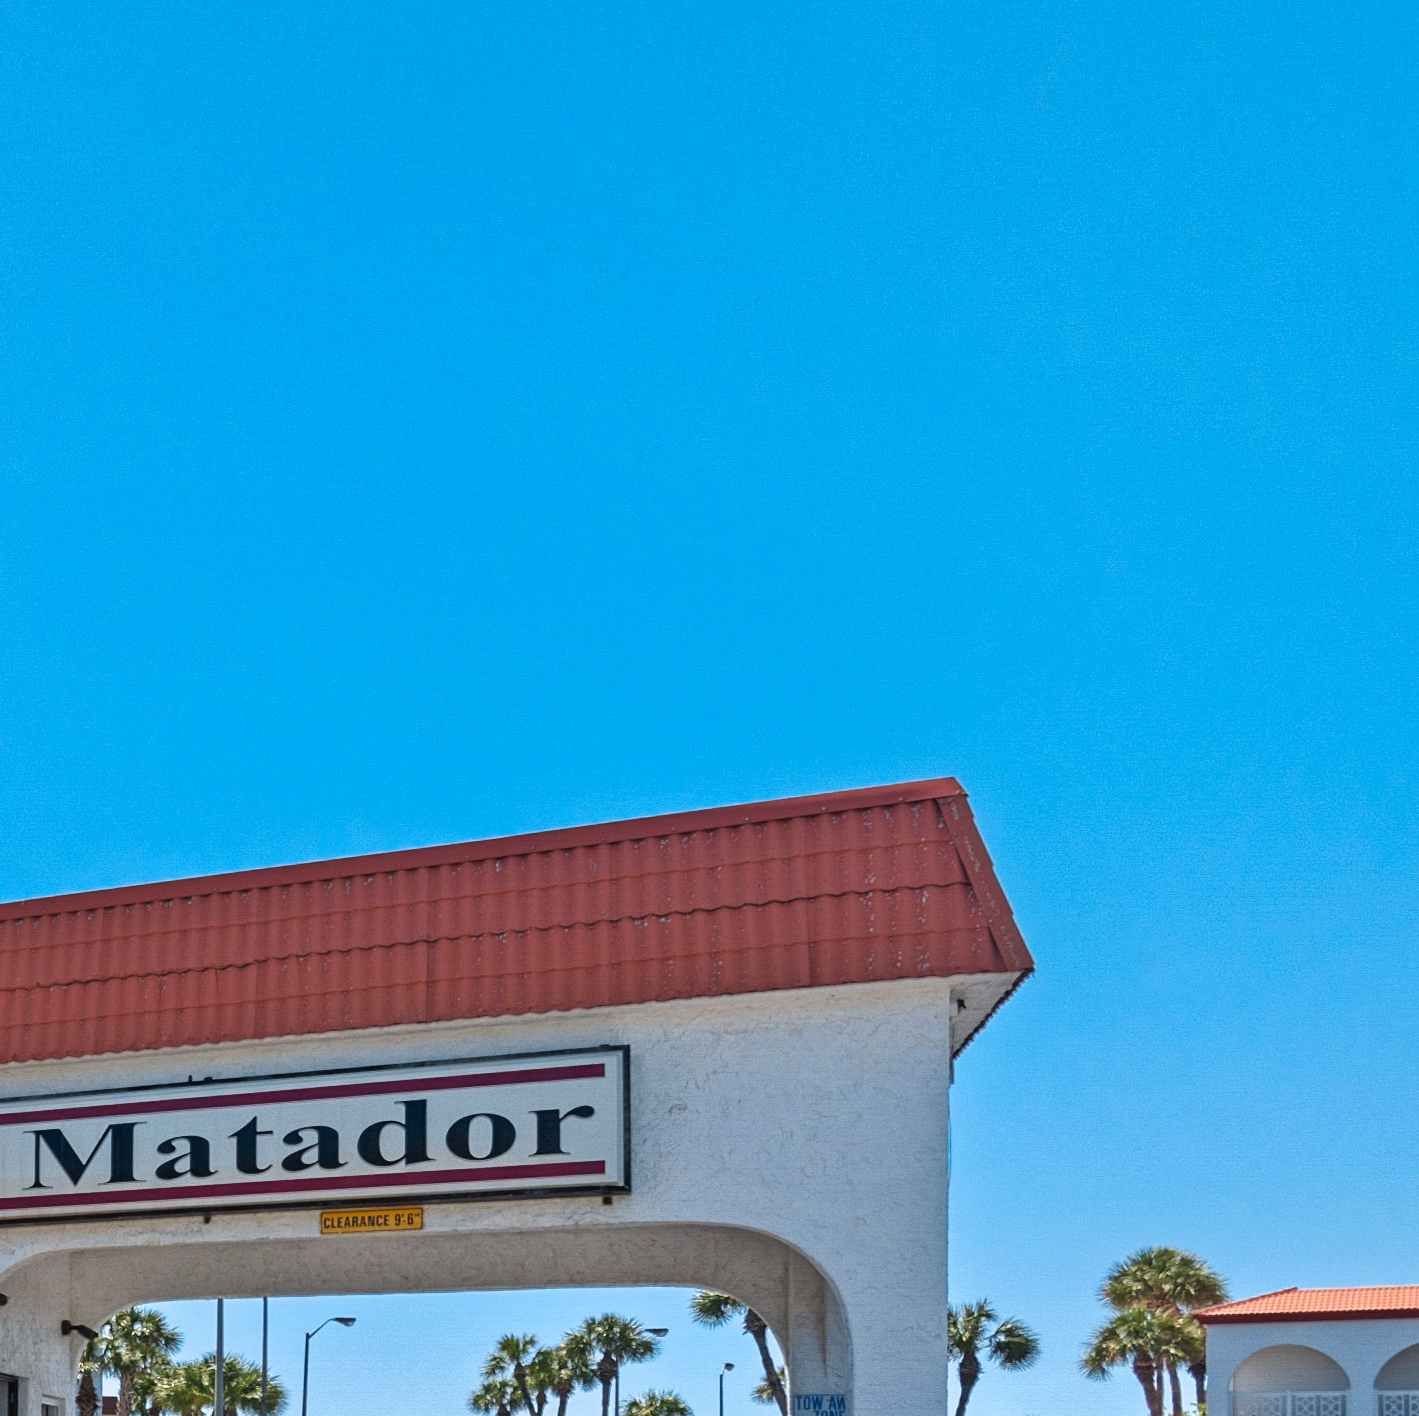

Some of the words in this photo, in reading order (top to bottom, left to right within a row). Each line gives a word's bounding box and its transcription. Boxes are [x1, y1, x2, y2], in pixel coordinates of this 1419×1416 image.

[24, 1098, 596, 1190] Matador
[323, 1214, 389, 1229] CLEARANCE
[795, 1395, 823, 1410] TOW
